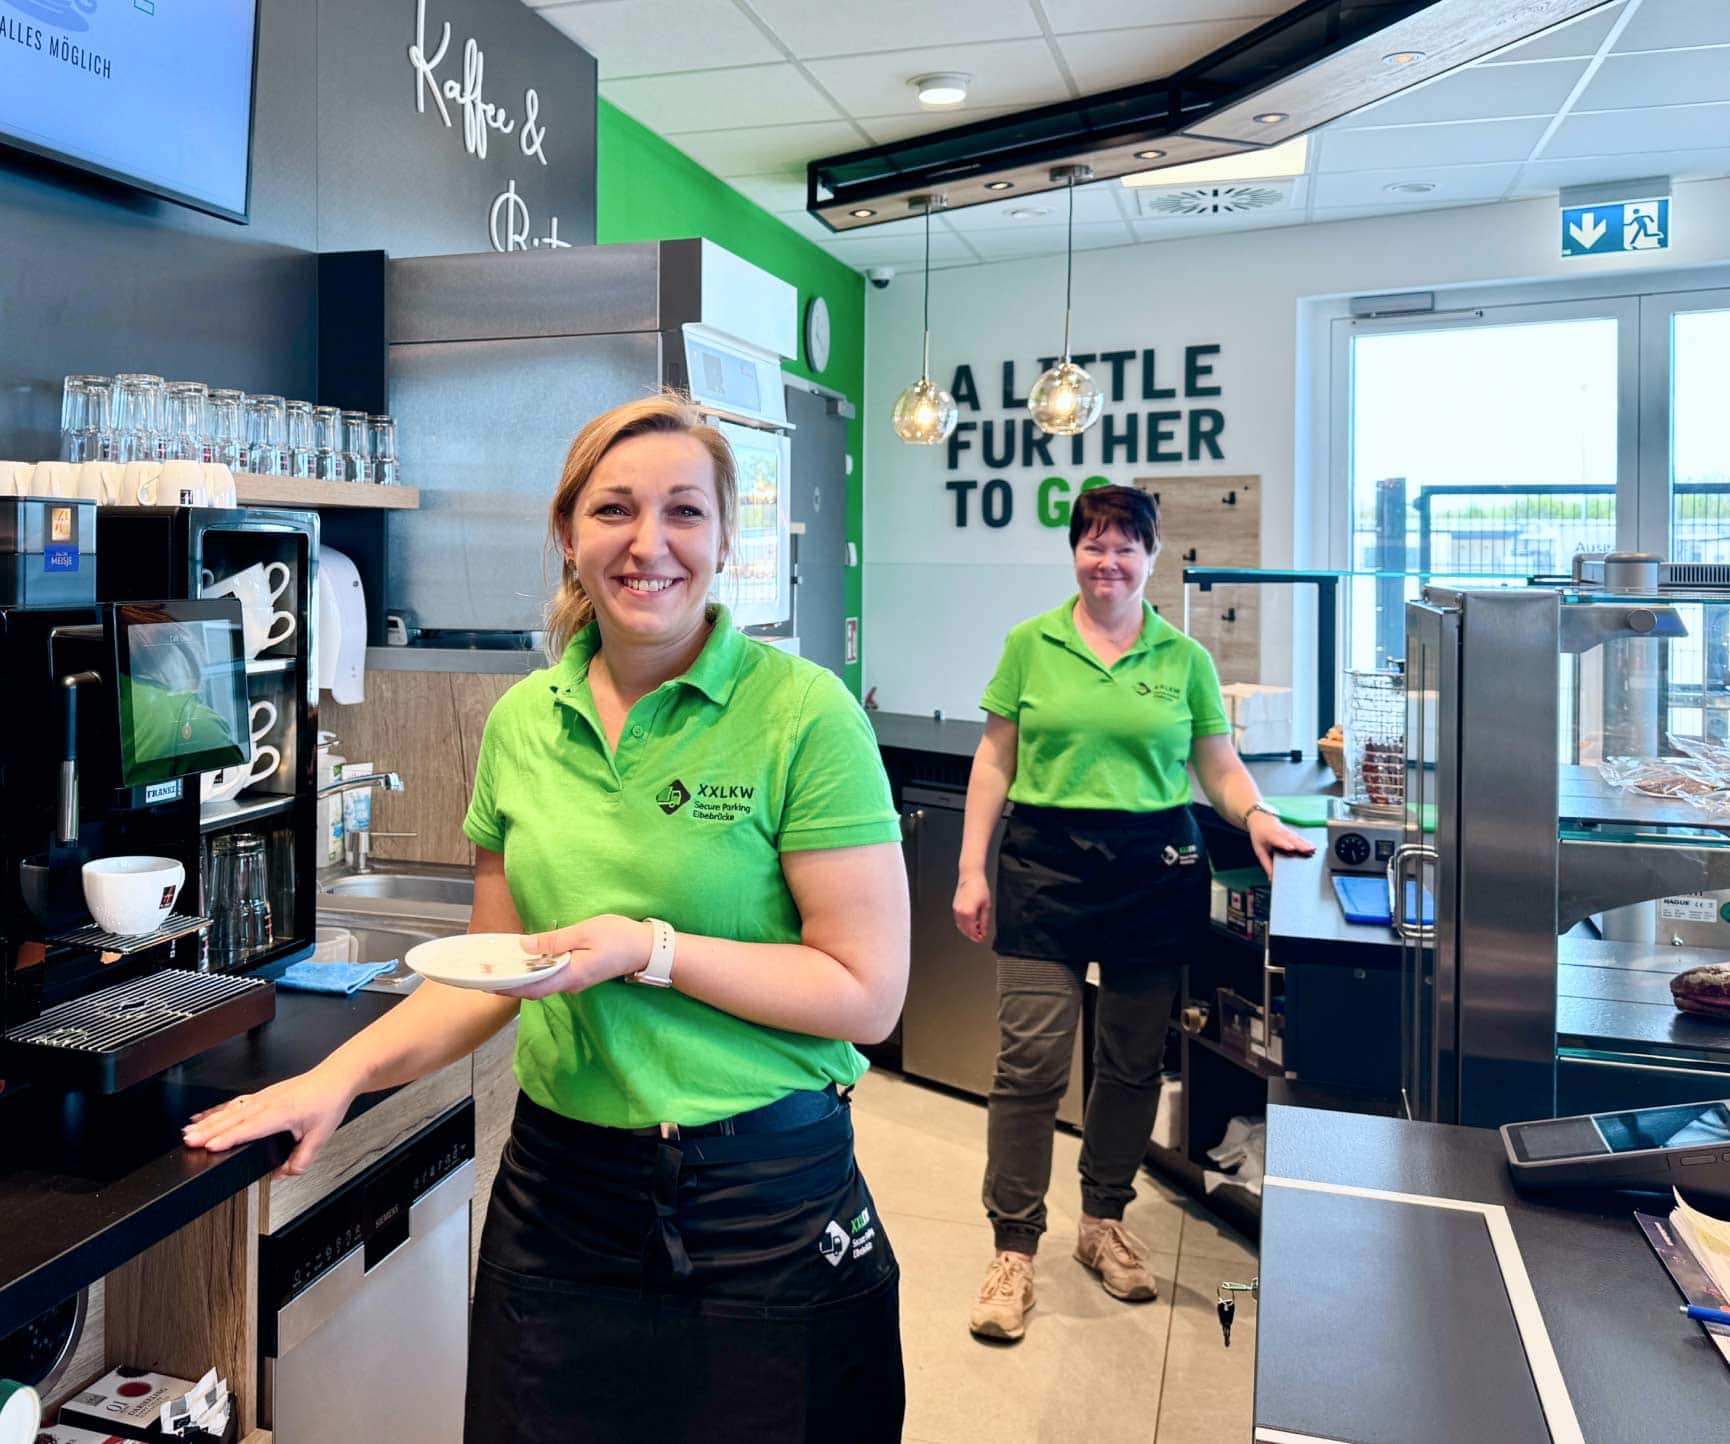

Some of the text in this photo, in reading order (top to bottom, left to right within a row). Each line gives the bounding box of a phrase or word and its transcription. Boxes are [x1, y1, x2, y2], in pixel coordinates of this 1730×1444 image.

[0, 15, 112, 80] ALLES MÖGLICH
[409, 0, 548, 165] Kaffee &
[951, 344, 1222, 411] A LTLE
[945, 475, 1112, 528] TO G
[694, 801, 752, 815] Secure Parking
[697, 783, 754, 800] XXLKW
